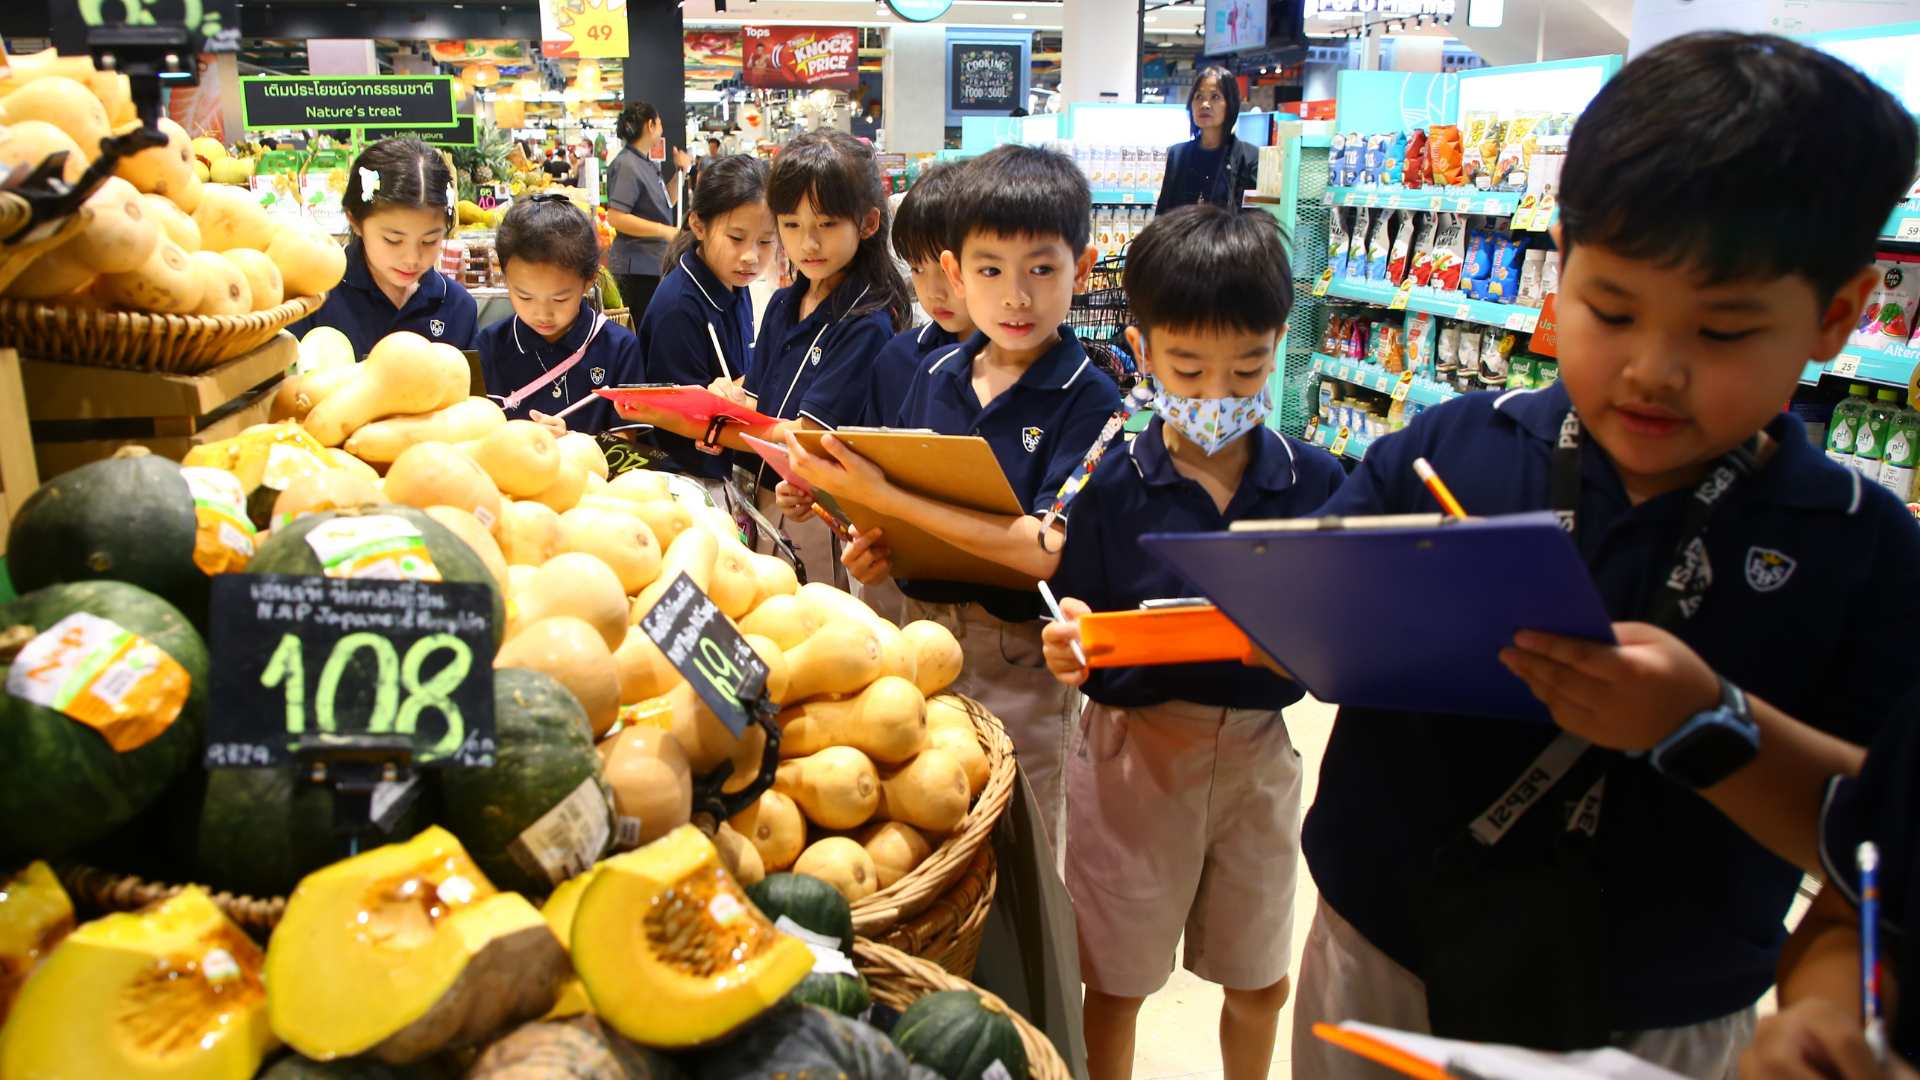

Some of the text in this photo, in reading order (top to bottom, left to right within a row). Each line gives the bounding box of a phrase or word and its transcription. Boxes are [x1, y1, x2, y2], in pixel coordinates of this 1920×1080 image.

[587, 25, 612, 41] 49
[744, 27, 770, 39] Tops
[794, 38, 855, 64] KNOCK
[807, 55, 849, 76] PRICE
[966, 58, 1007, 72] COOKING
[264, 81, 434, 97] เติมประโยชน์จากธรรมชาติ
[965, 85, 983, 98] FOOD
[987, 86, 1007, 98] SOUL
[305, 105, 403, 118] Nature's treat
[421, 131, 444, 140] yours
[1356, 182, 1404, 195] Health Specific
[1421, 183, 1479, 197] Health Specific
[1907, 227, 1919, 236] 59
[1345, 272, 1395, 291] Health Specific
[1435, 287, 1468, 304] Specific
[1339, 354, 1386, 376] Health Specific
[1512, 361, 1531, 375] equal
[1841, 362, 1853, 372] 25
[1540, 367, 1559, 380] equal
[1424, 378, 1454, 397] Specific
[260, 631, 473, 763] 108
